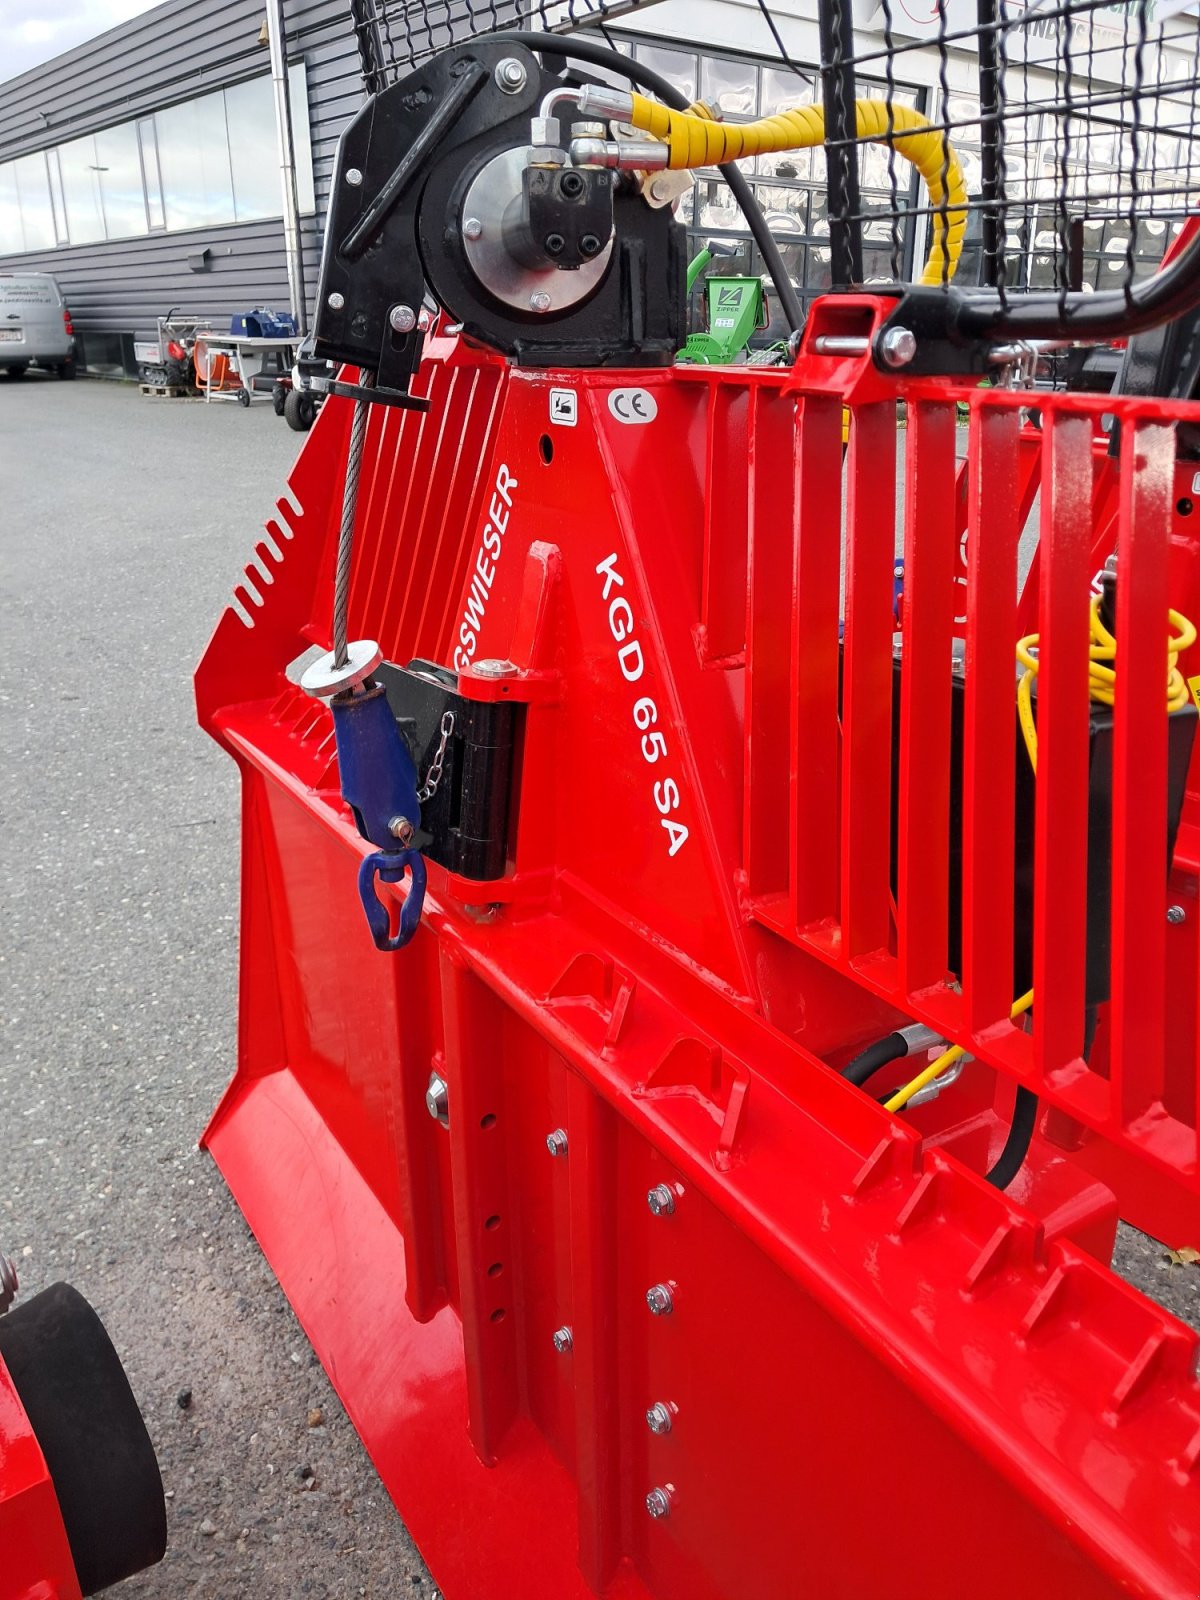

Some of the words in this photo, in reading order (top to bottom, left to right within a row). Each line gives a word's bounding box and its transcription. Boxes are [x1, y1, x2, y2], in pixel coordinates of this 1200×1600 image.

[614, 393, 647, 418] CE
[595, 552, 644, 682] KGD
[633, 697, 668, 763] 65
[653, 777, 689, 857] SA
